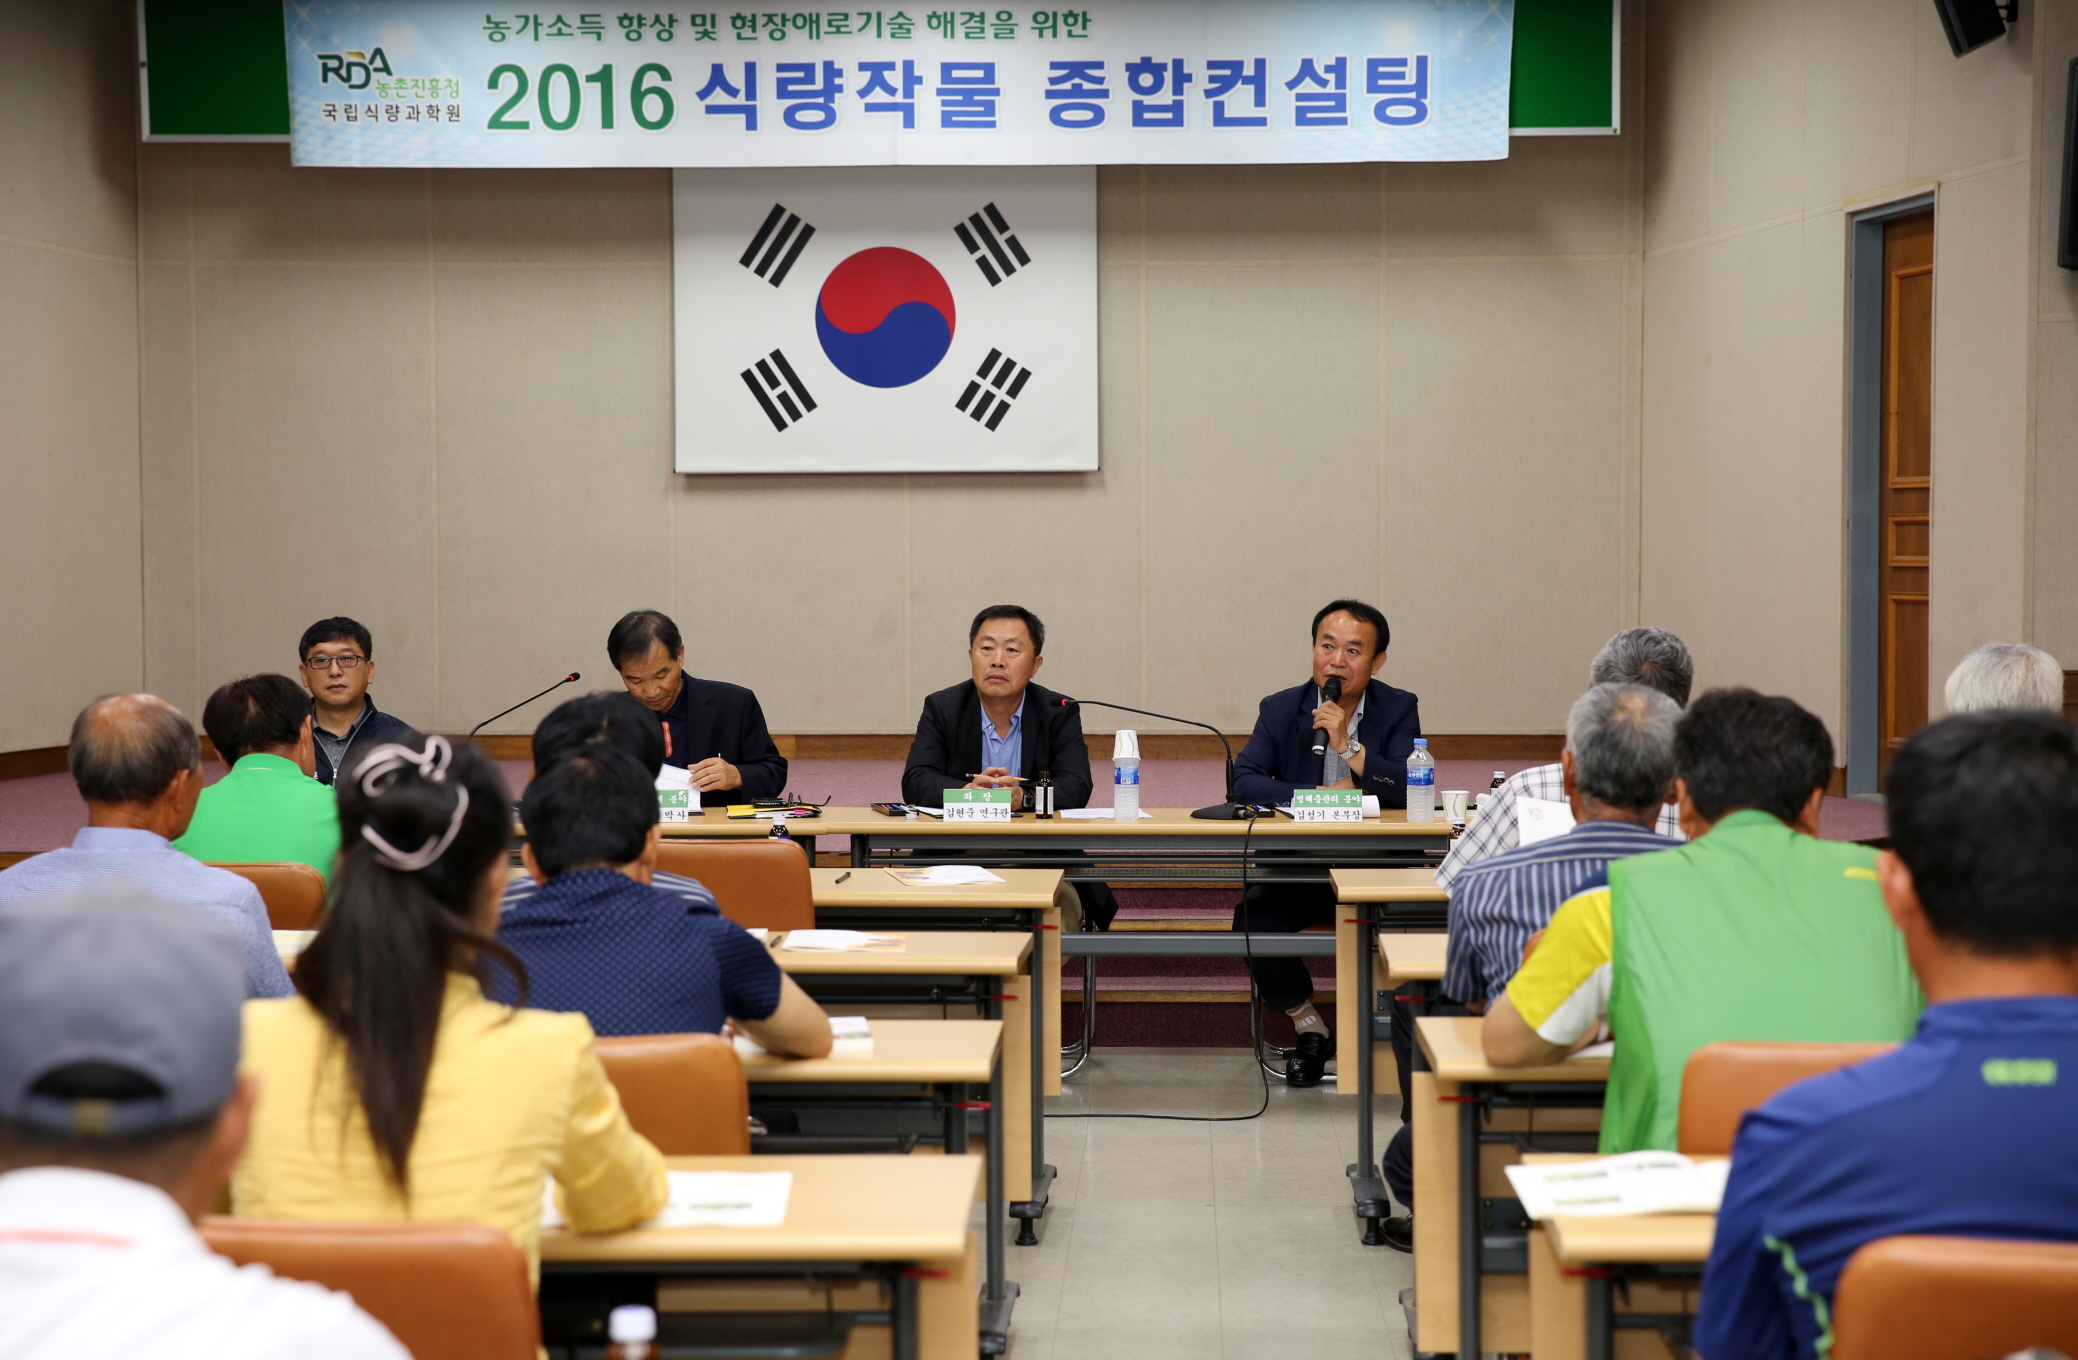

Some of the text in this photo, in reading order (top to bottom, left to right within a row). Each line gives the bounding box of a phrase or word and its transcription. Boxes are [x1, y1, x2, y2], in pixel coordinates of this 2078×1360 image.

[483, 11, 1091, 42] 농가소득 향상 및 현장애로기술 해결을 위한
[316, 47, 394, 90] RDA
[375, 77, 460, 99] 농촌진흥청
[486, 55, 1428, 131] 2016 식량작물 종합컨설팅
[322, 103, 461, 122] 국립식량과학원
[1343, 793, 1361, 804] 분야
[979, 807, 1010, 818] 연구관
[1331, 810, 1361, 820] 본부장
